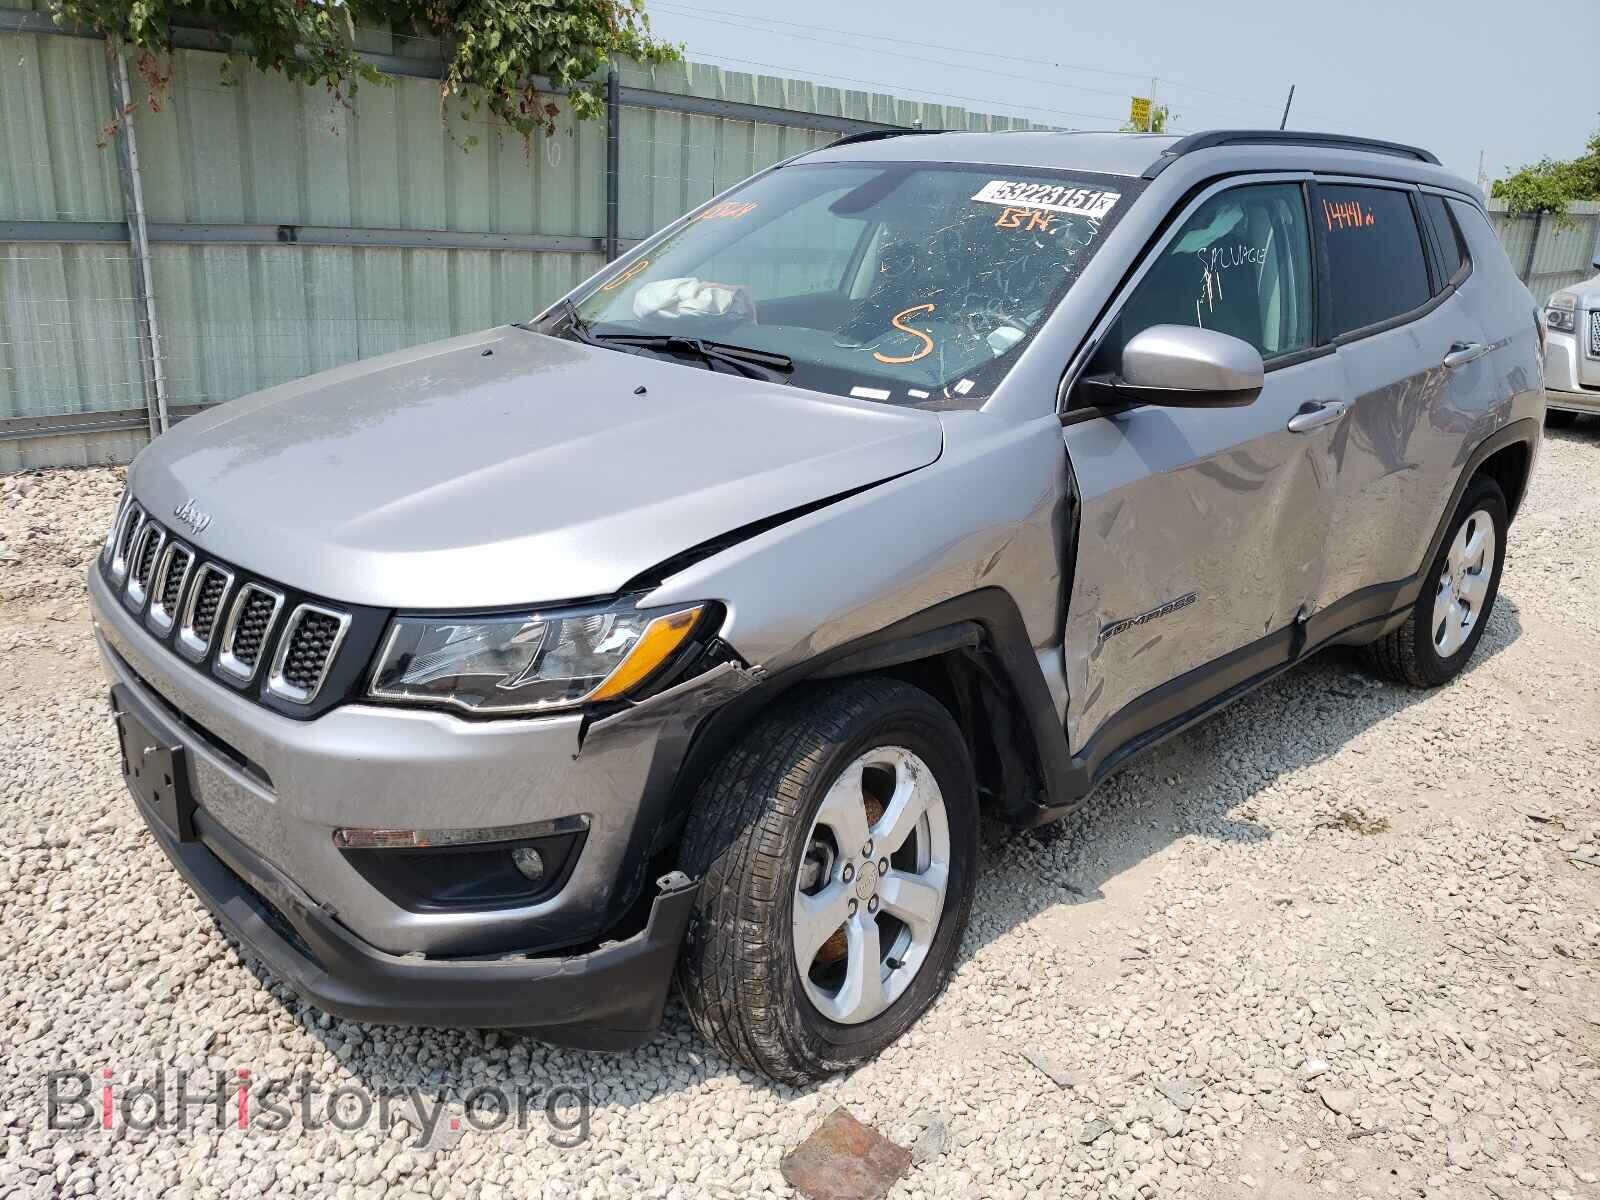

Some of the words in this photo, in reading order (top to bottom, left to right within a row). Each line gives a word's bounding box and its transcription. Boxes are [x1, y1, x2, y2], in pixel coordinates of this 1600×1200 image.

[992, 181, 1099, 211] 53223151
[872, 303, 936, 364] S
[174, 499, 212, 535] Jeep
[1099, 593, 1198, 641] COMPASS
